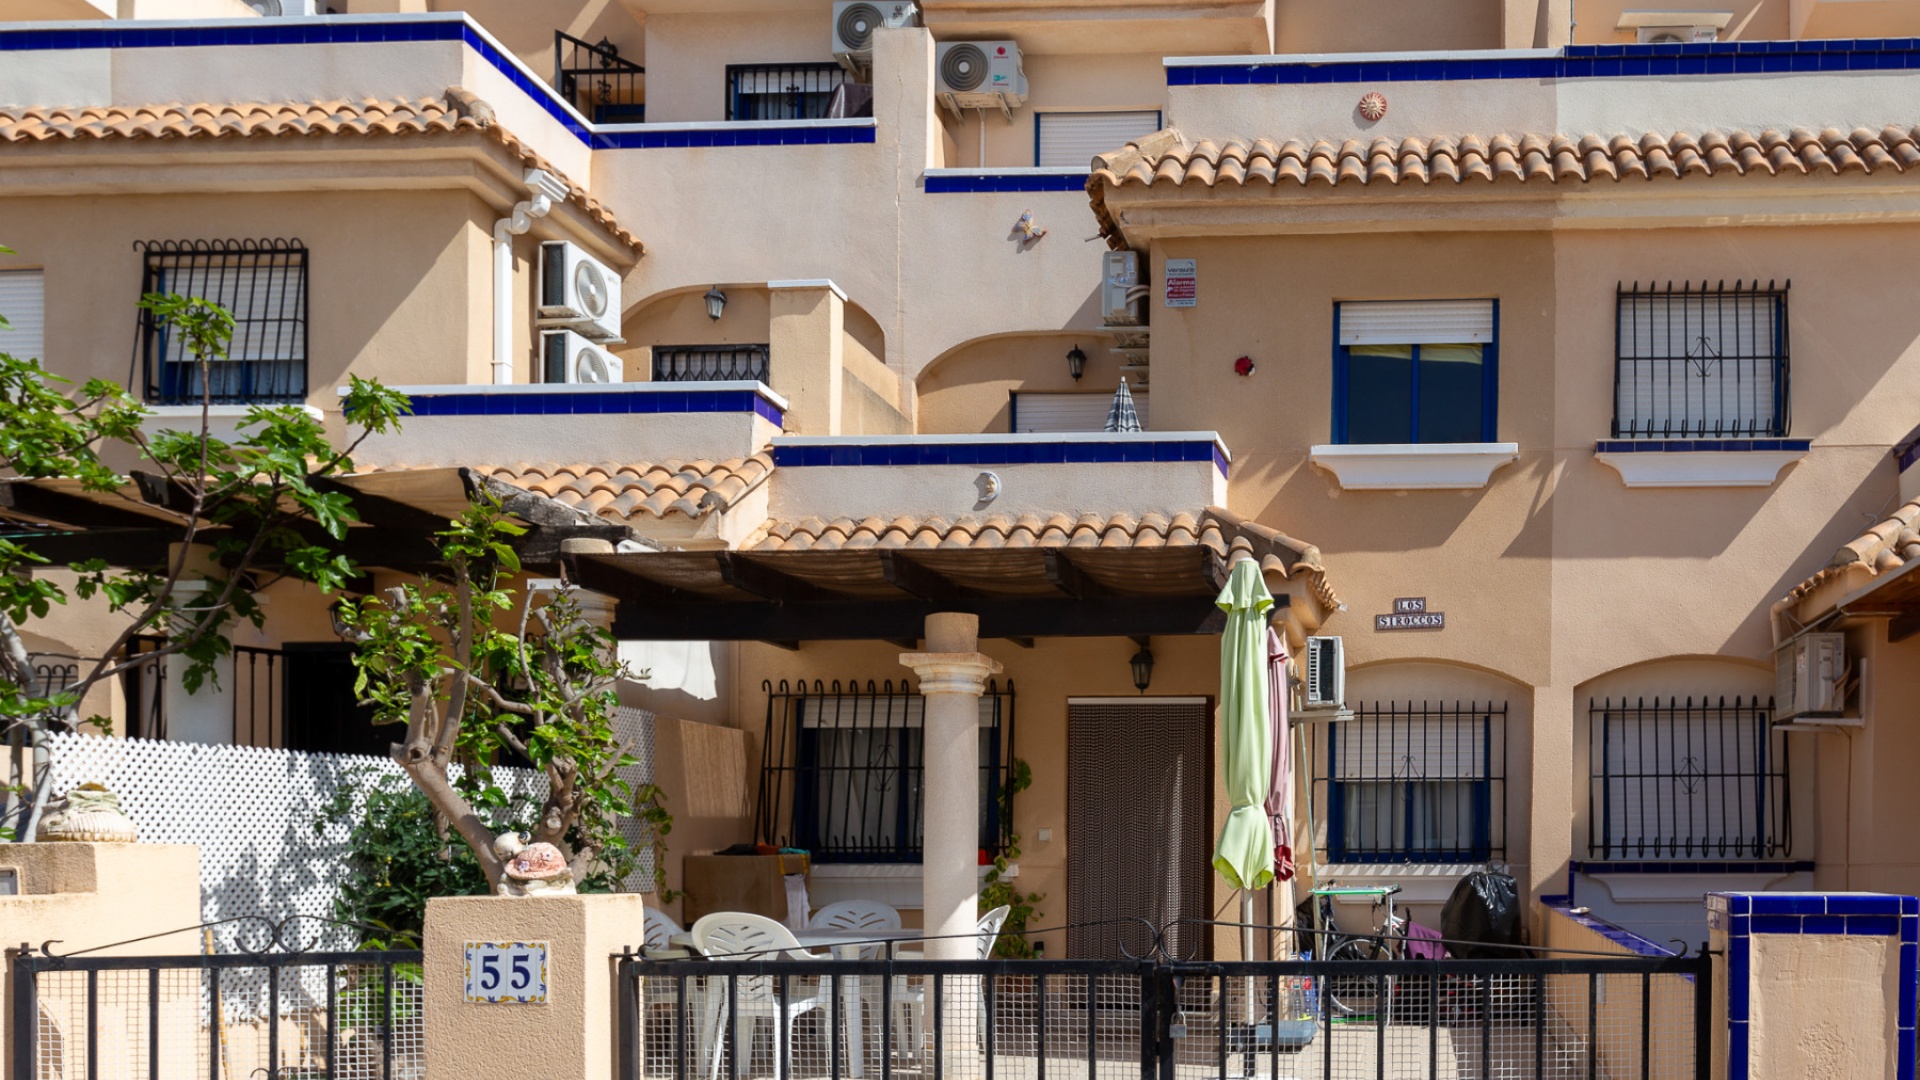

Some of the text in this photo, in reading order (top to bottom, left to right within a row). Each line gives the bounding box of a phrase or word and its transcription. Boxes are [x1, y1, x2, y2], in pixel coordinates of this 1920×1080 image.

[1400, 600, 1422, 610] LOS
[1379, 615, 1441, 626] SIROCCOS
[480, 954, 531, 990] 55
